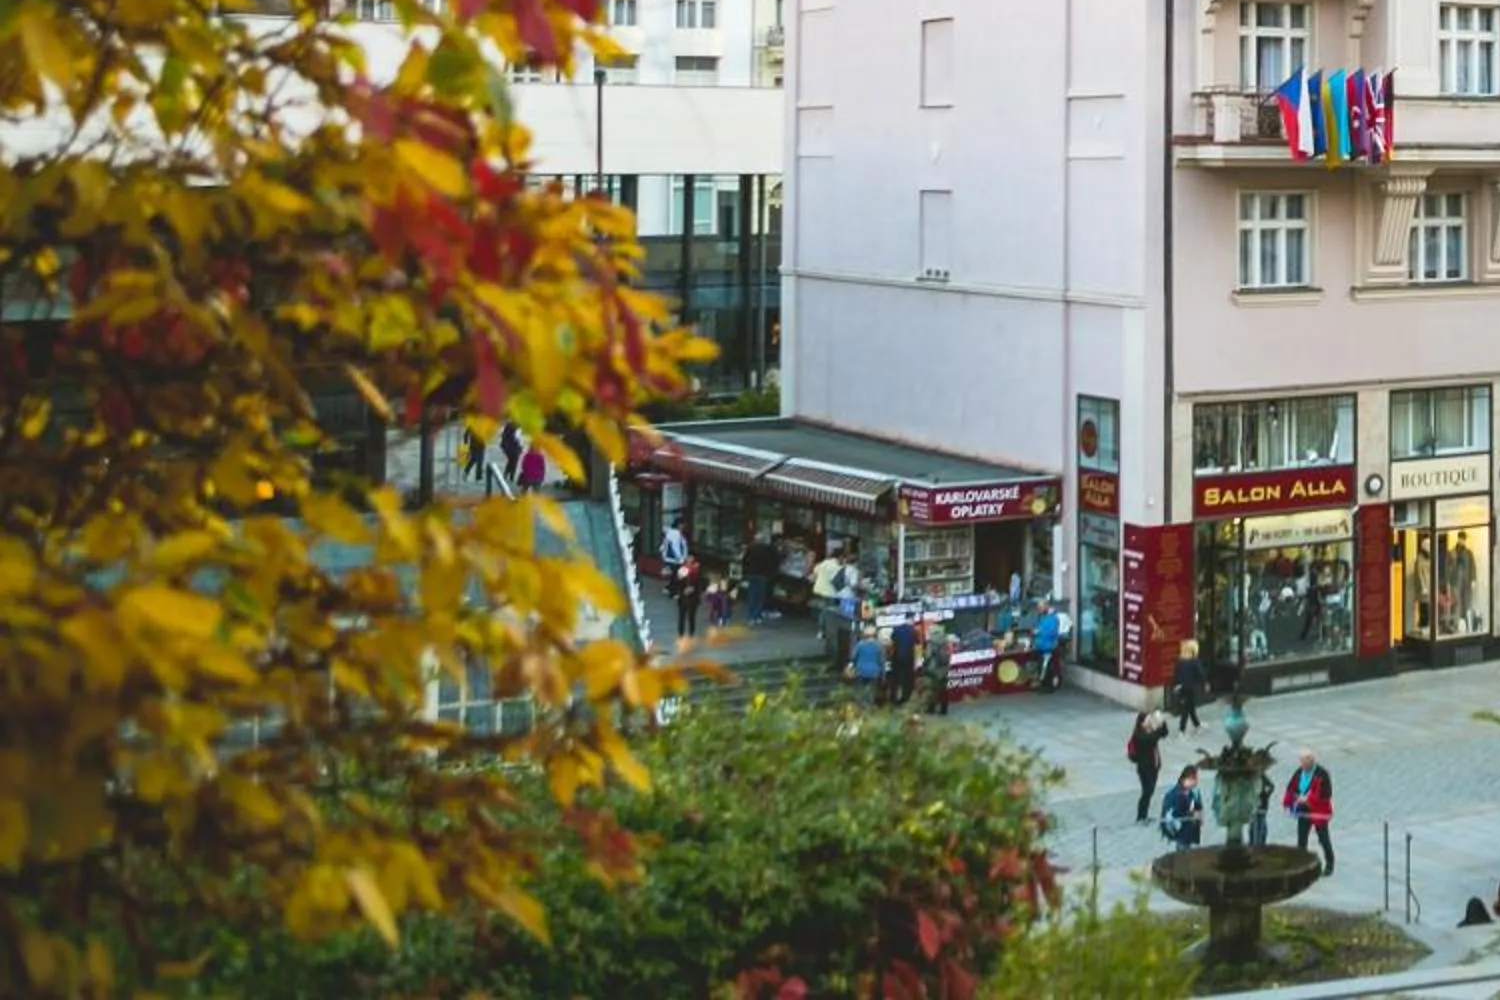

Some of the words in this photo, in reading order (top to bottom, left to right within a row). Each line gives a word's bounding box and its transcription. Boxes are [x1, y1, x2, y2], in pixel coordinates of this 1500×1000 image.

[1401, 466, 1479, 489] BOUTIQUE
[935, 485, 1020, 505] KARLOVARSKÉ
[951, 503, 1005, 519] OPLATKY
